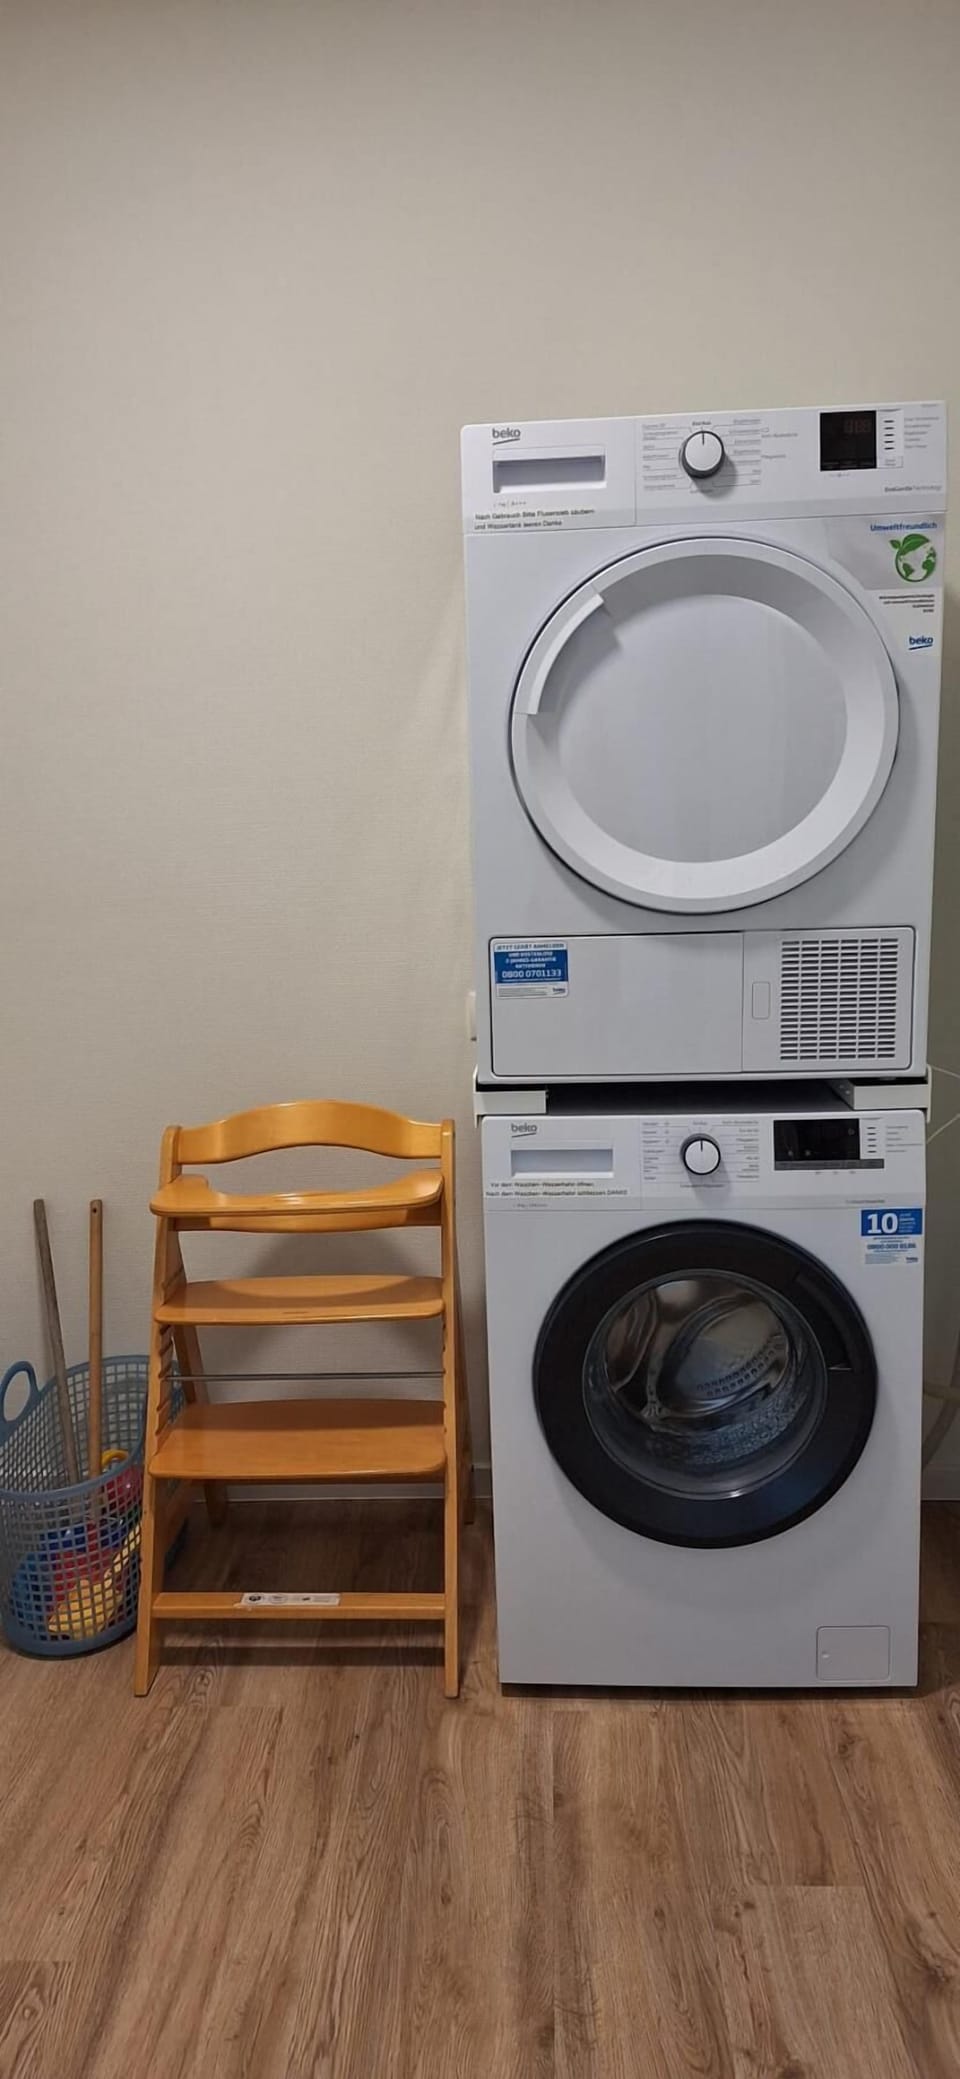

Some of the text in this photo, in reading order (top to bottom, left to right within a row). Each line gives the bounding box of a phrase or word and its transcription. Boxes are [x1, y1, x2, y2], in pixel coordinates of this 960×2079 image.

[492, 427, 521, 440] beko
[908, 635, 934, 645] beko
[501, 970, 524, 978] 0800
[511, 1123, 538, 1133] beko
[867, 1212, 899, 1234] 10
